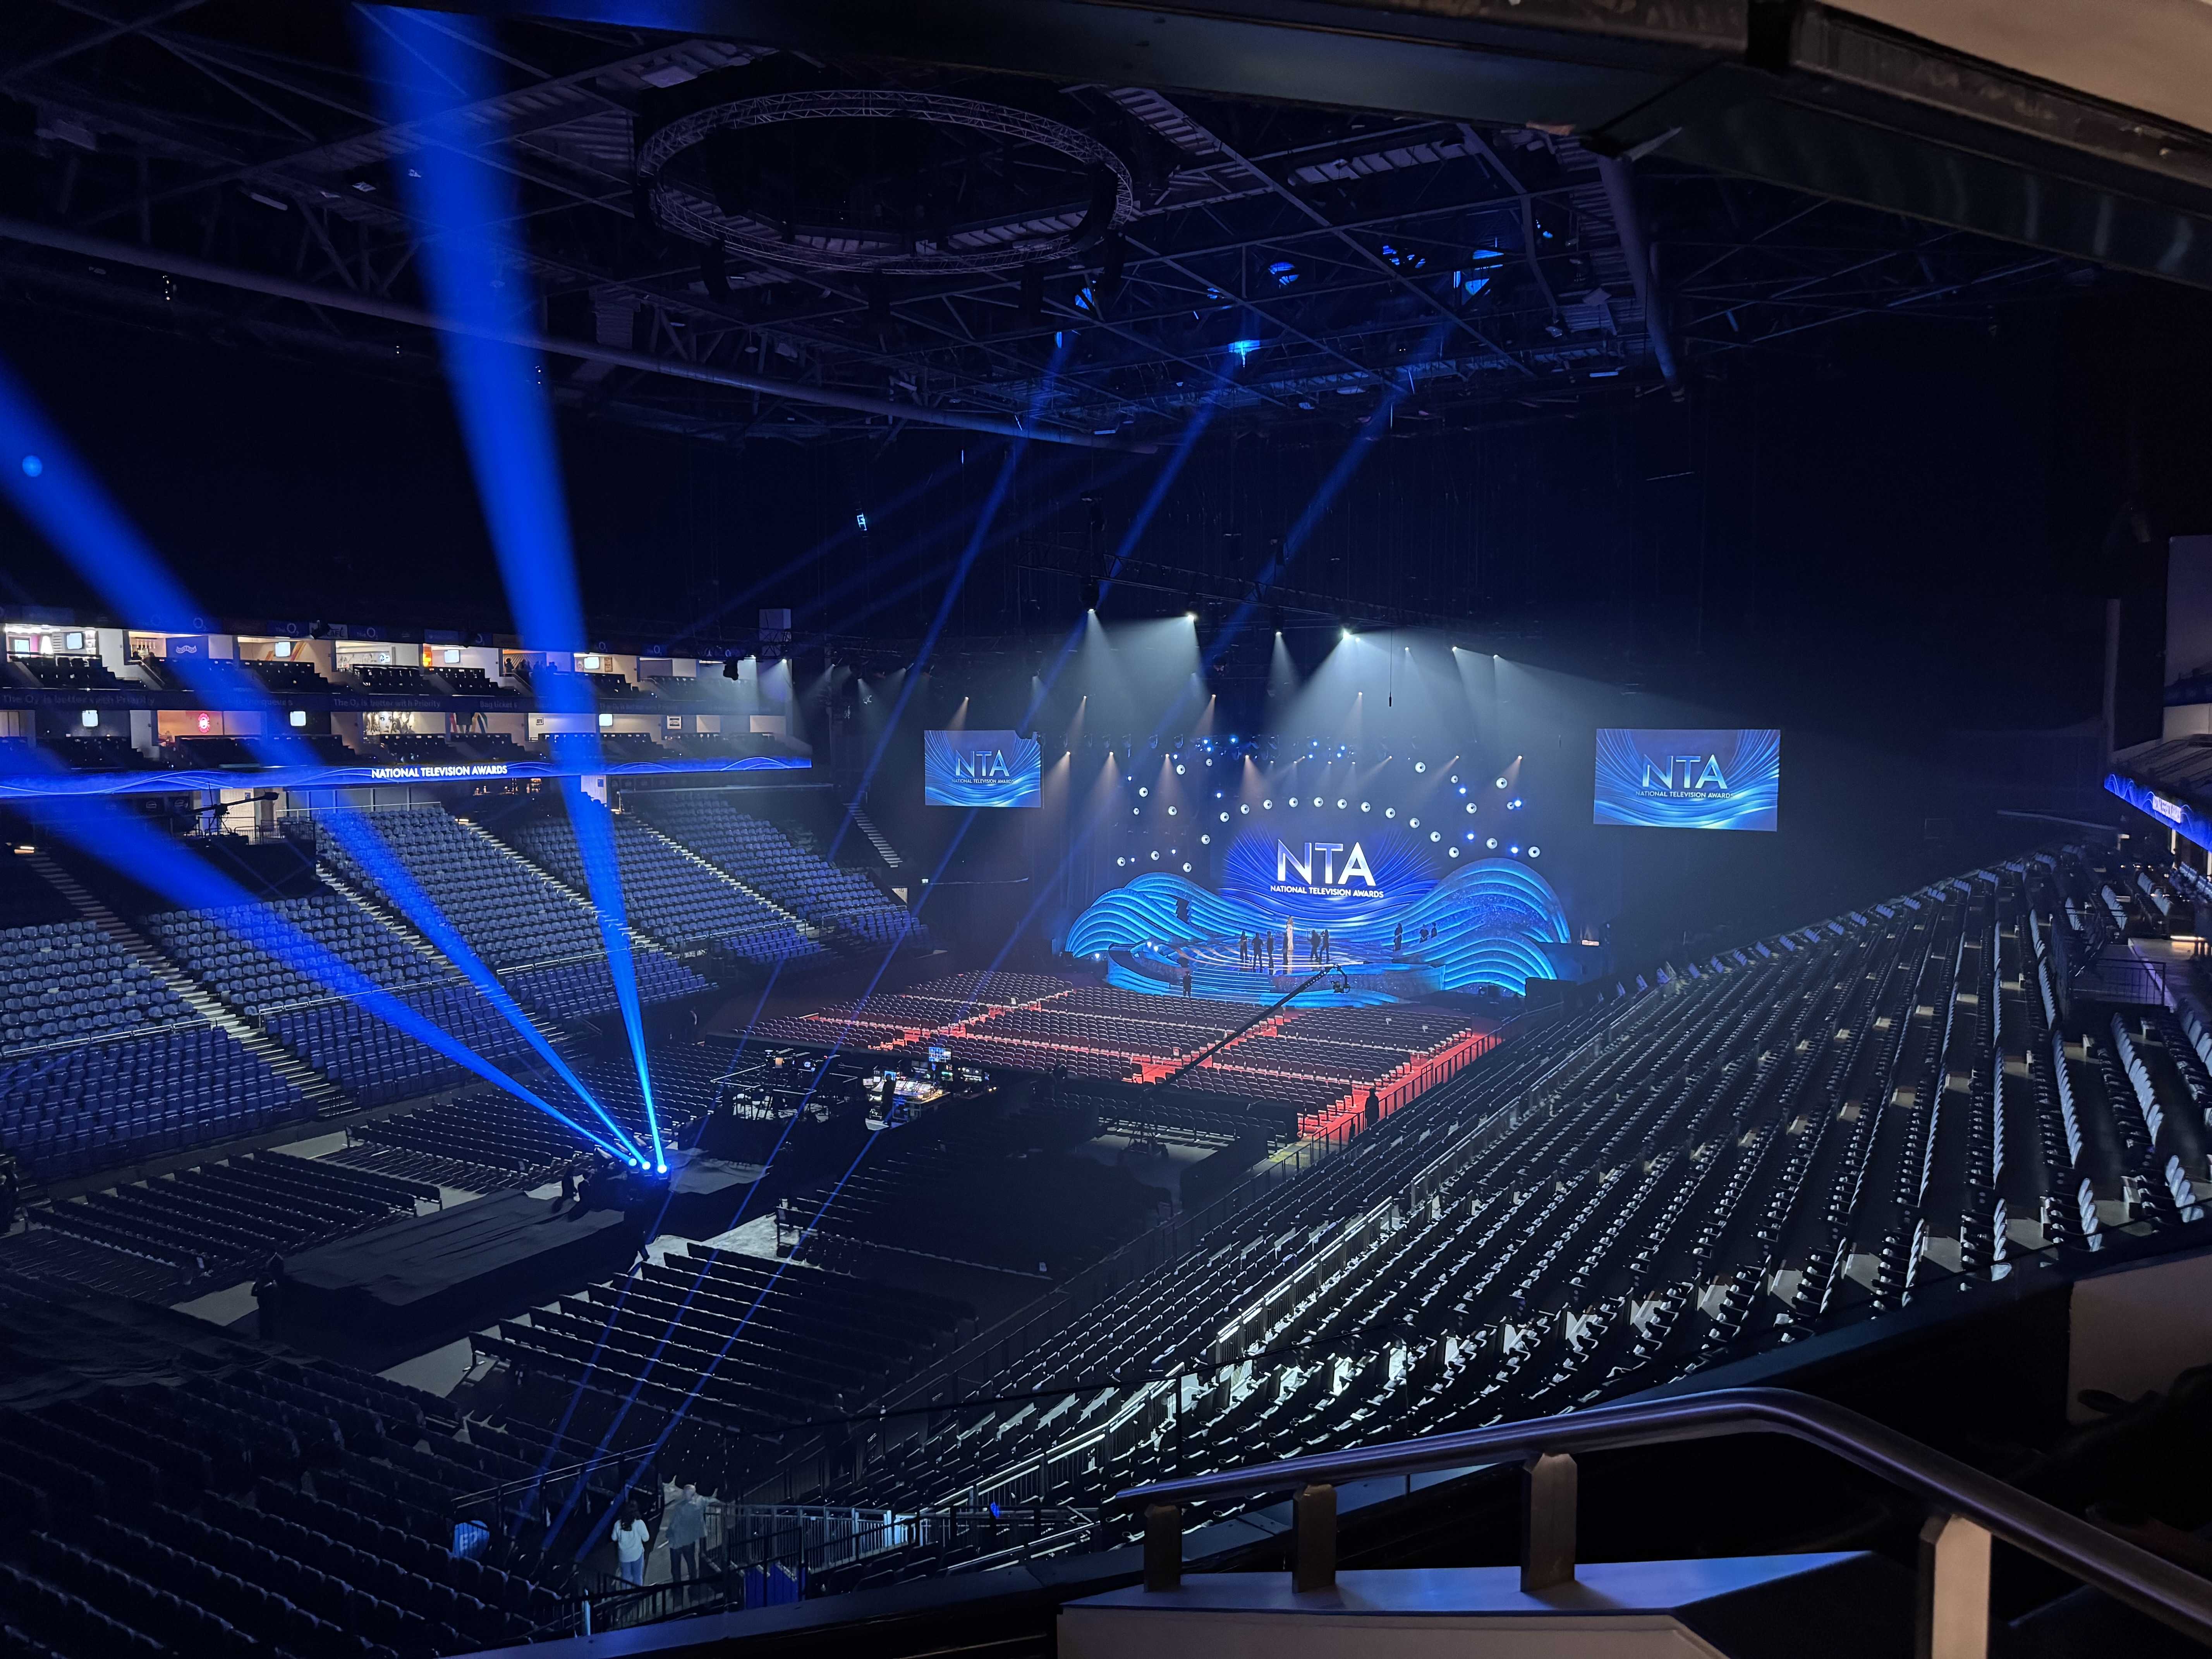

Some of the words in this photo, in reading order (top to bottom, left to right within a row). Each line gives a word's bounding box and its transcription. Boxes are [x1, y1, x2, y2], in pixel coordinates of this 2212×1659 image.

[370, 699, 393, 707] better
[414, 700, 440, 708] Priority
[480, 701, 493, 709] Bag
[955, 749, 1010, 777] NTA
[371, 768, 419, 778] NATIONAL
[421, 766, 471, 777] TELEVISION
[472, 765, 508, 775] AWARDS
[1642, 754, 1728, 789] NTA
[1277, 839, 1376, 886] NTA
[1270, 885, 1307, 894] NATIONAL
[1309, 887, 1351, 897] TELEVISION
[1353, 890, 1384, 898] AWARDS
